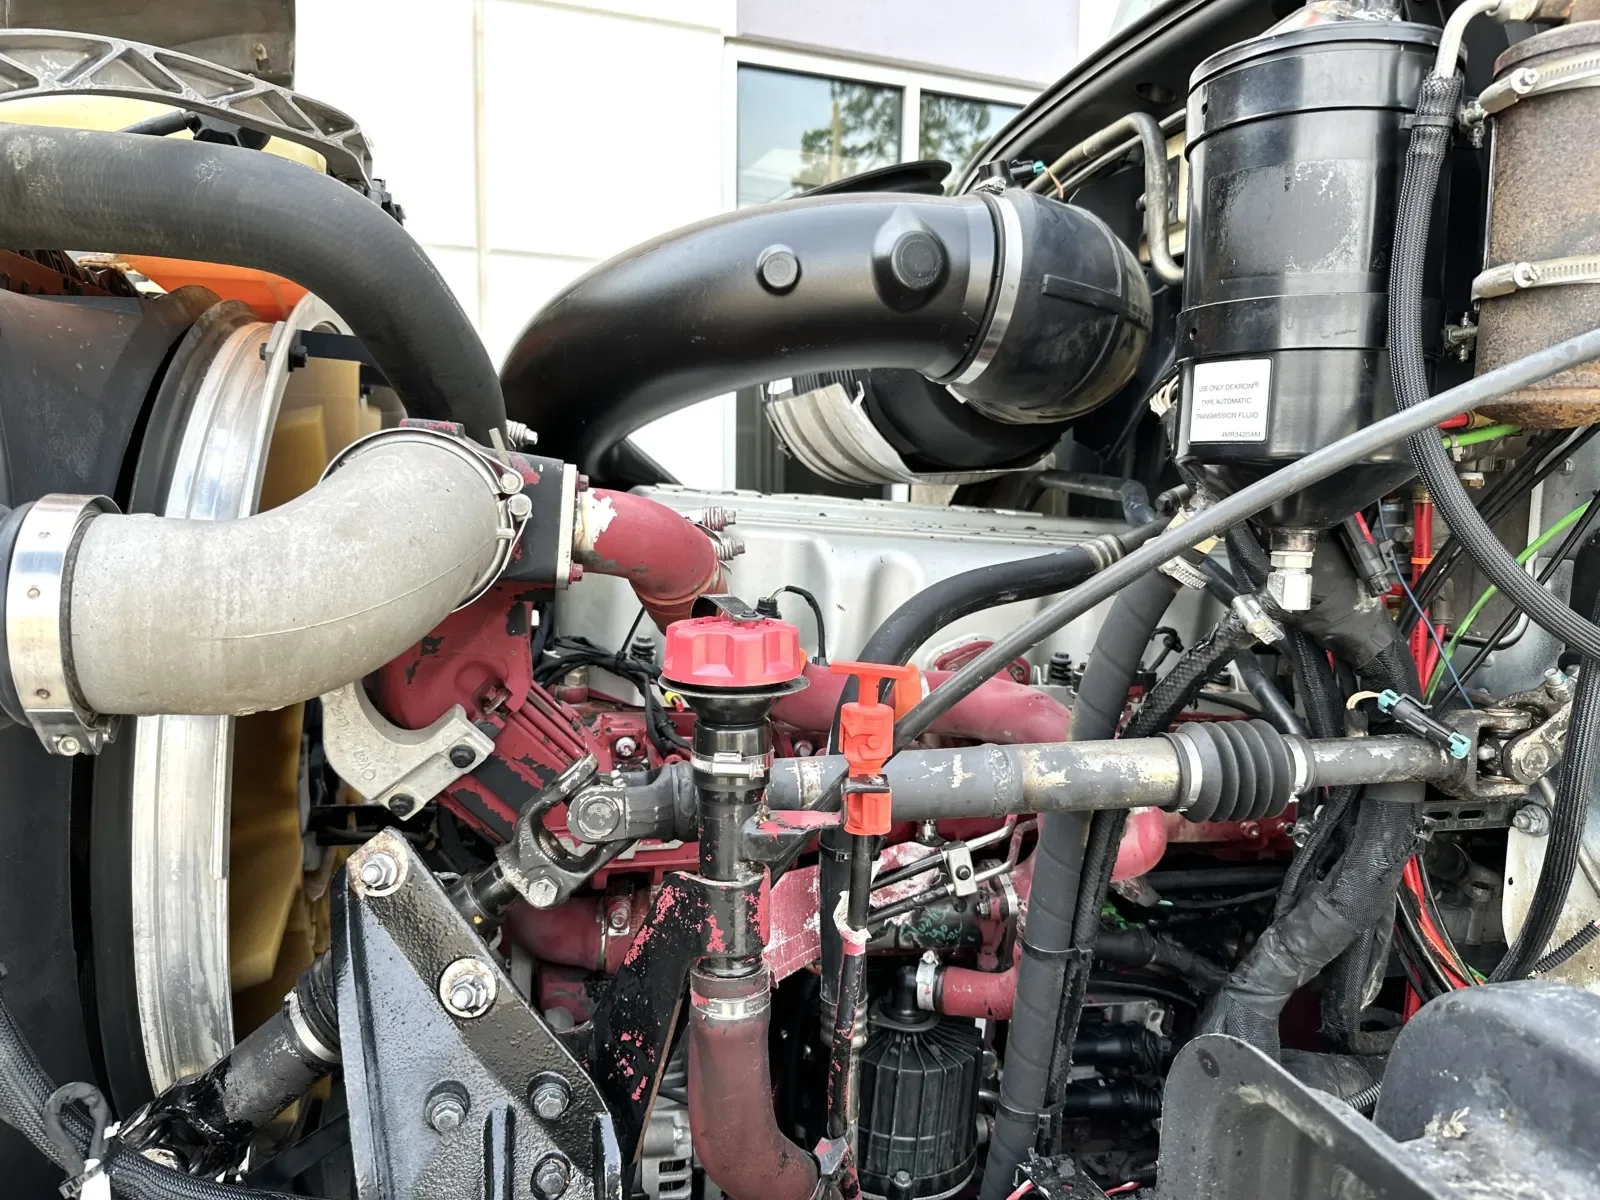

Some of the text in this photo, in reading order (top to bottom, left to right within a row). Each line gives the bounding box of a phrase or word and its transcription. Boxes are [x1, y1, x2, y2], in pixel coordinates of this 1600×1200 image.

[1215, 397, 1252, 405] AUTOMATIC
[1195, 411, 1259, 420] TRANSMISSION FLUID
